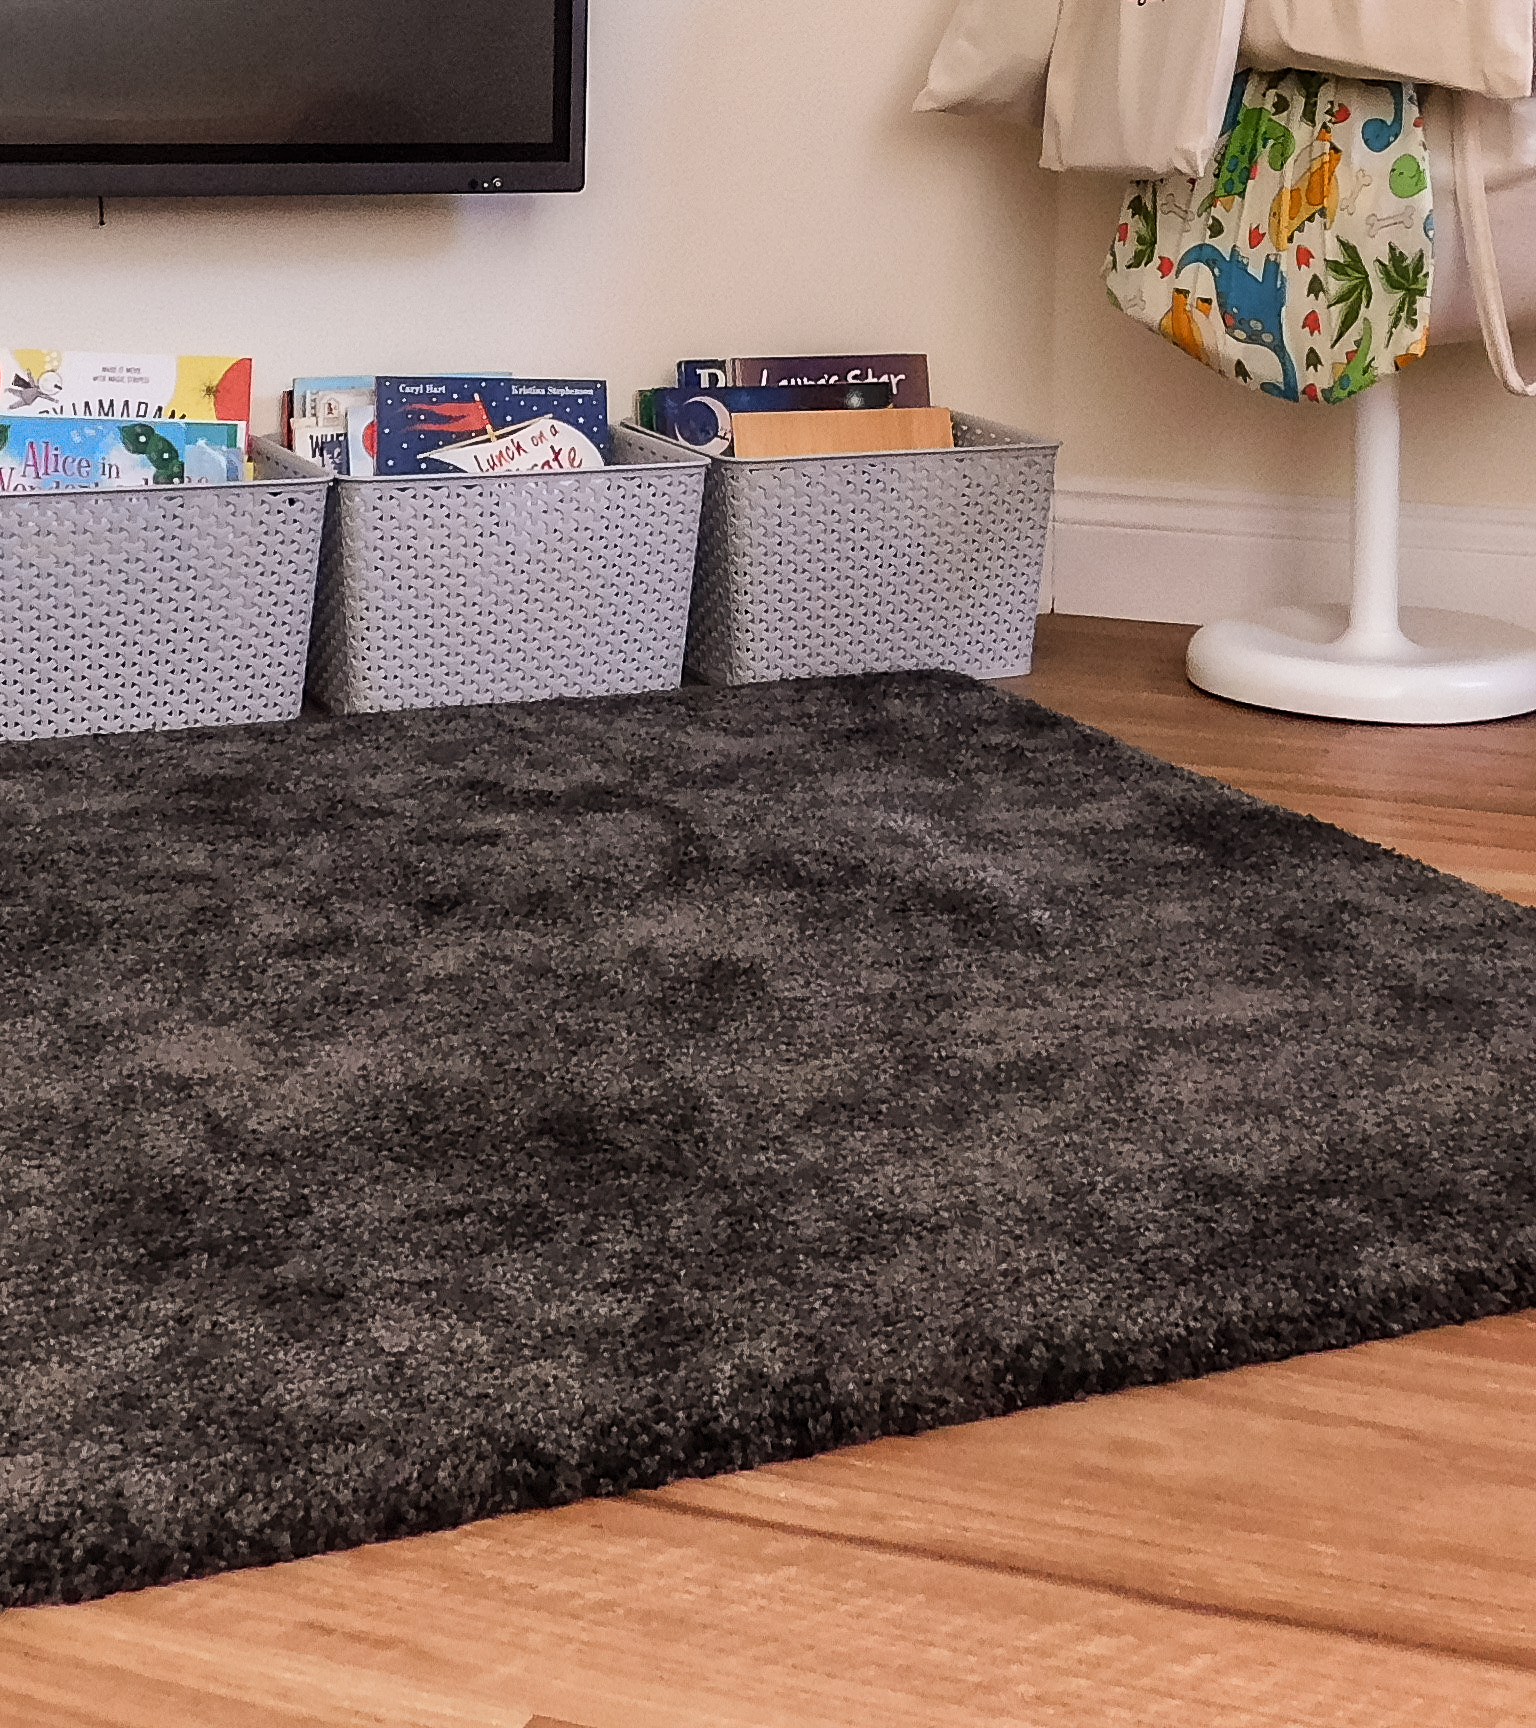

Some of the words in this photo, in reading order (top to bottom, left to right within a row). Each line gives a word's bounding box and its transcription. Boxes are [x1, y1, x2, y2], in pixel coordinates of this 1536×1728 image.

[531, 430, 548, 447] on
[550, 424, 559, 437] a
[21, 441, 91, 480] Alice
[101, 456, 121, 480] in
